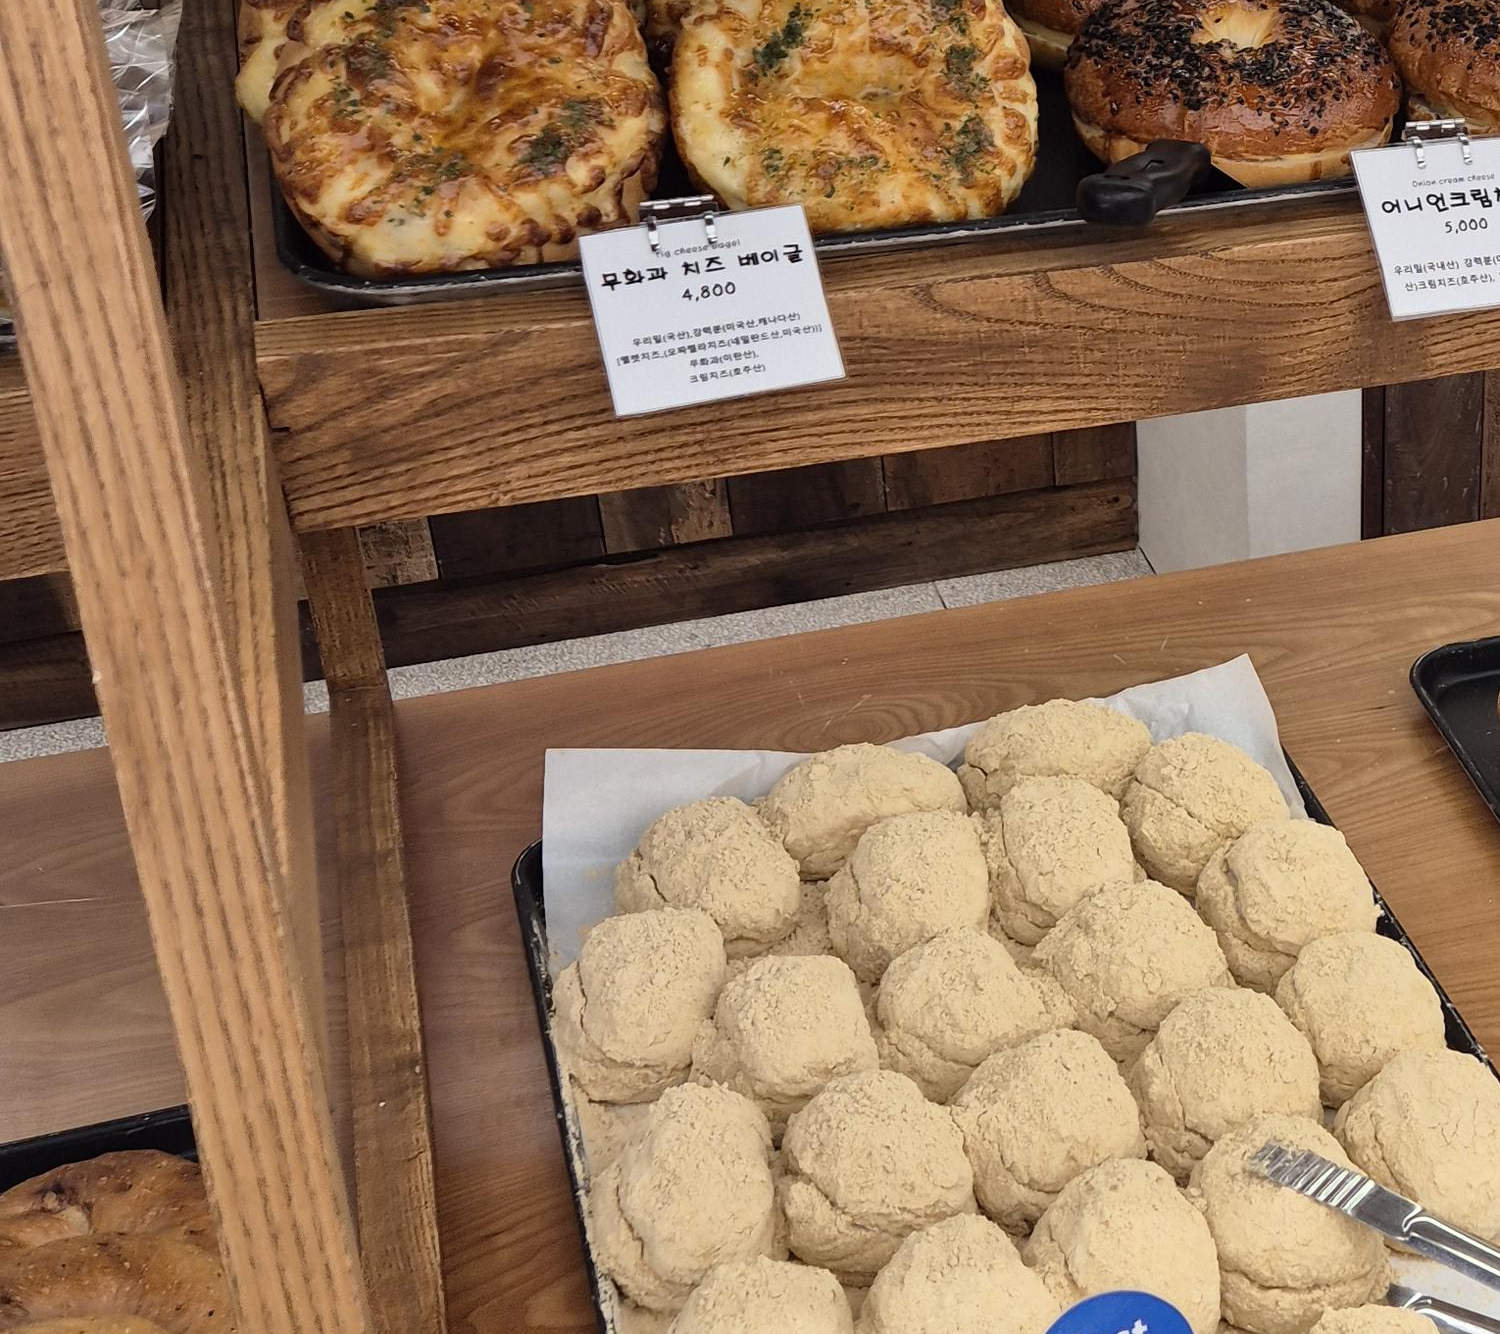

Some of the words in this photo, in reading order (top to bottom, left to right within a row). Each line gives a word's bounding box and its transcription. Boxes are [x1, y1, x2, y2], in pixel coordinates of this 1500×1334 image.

[1444, 217, 1488, 234] 5,000
[601, 267, 668, 291] 무화과
[682, 256, 726, 276] 치즈
[737, 243, 803, 269] 베이글
[682, 281, 736, 302] 4,800
